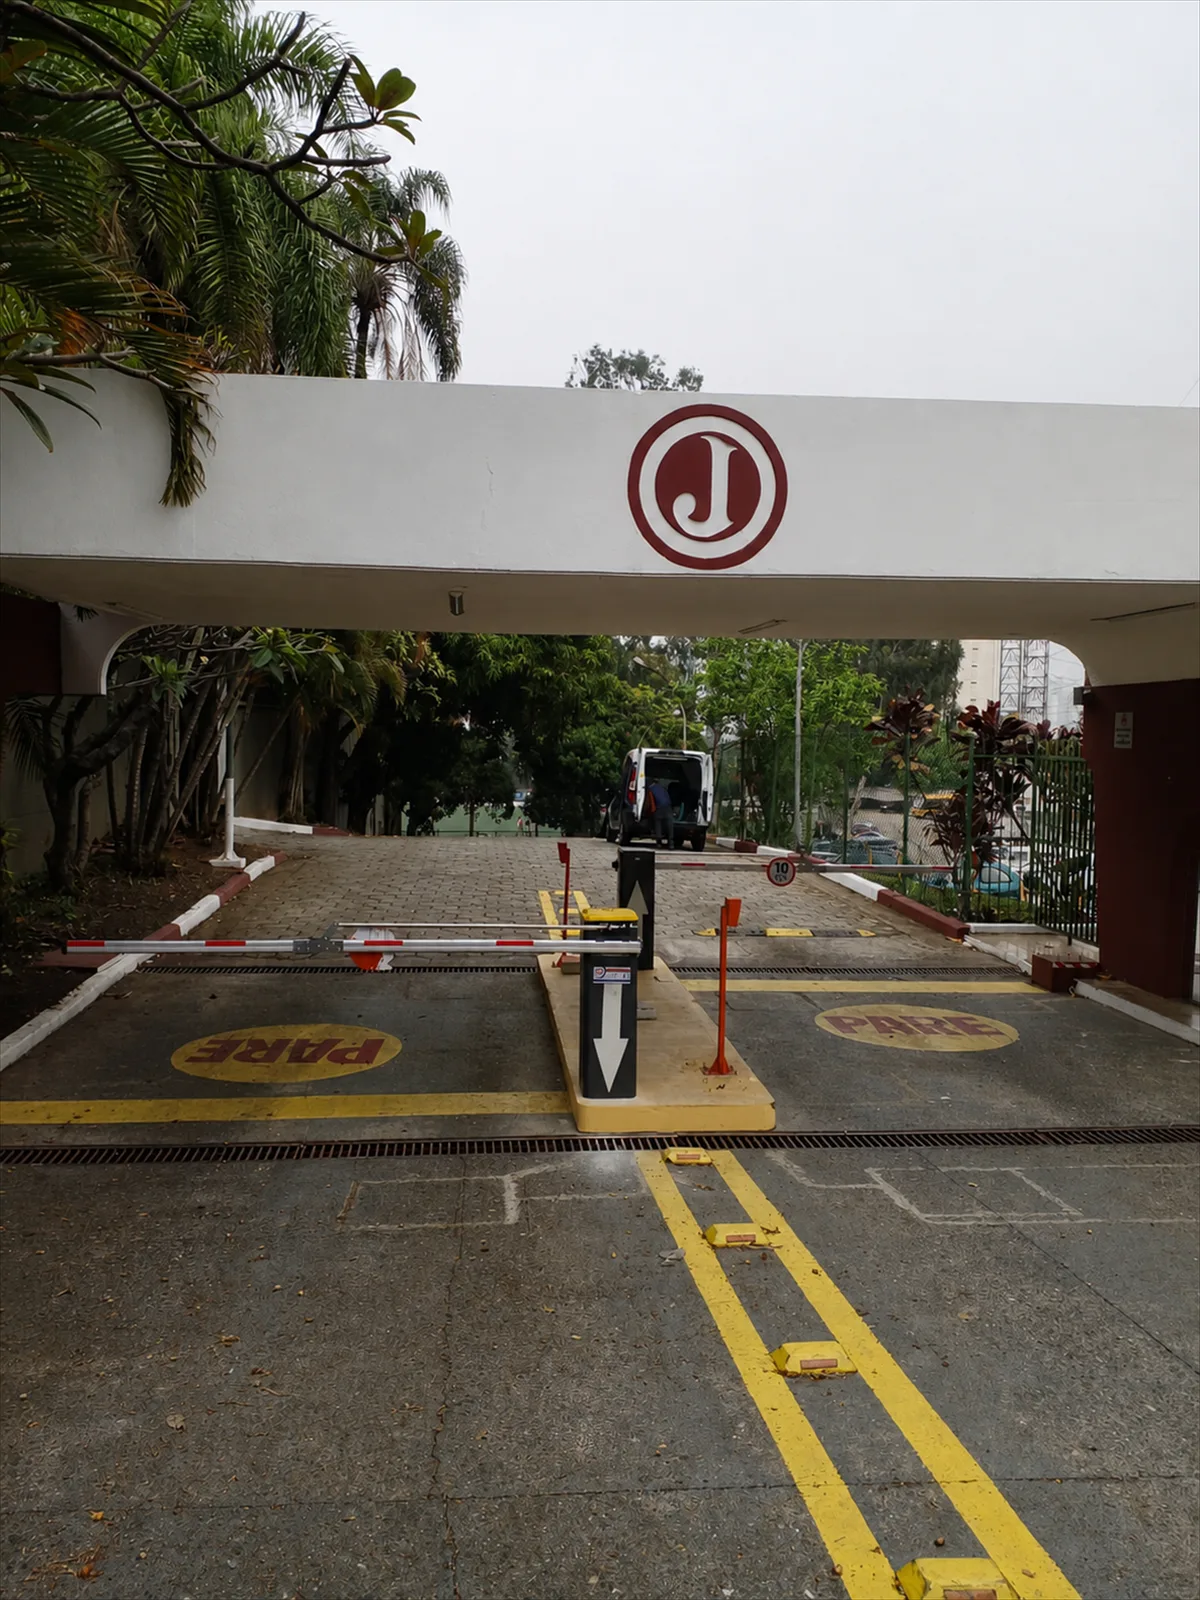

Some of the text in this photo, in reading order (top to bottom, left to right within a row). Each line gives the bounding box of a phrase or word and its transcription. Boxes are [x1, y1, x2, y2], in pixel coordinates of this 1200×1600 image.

[672, 435, 738, 538] J
[774, 862, 789, 874] 10
[824, 1015, 1005, 1036] PARE
[185, 1038, 385, 1064] PARE
